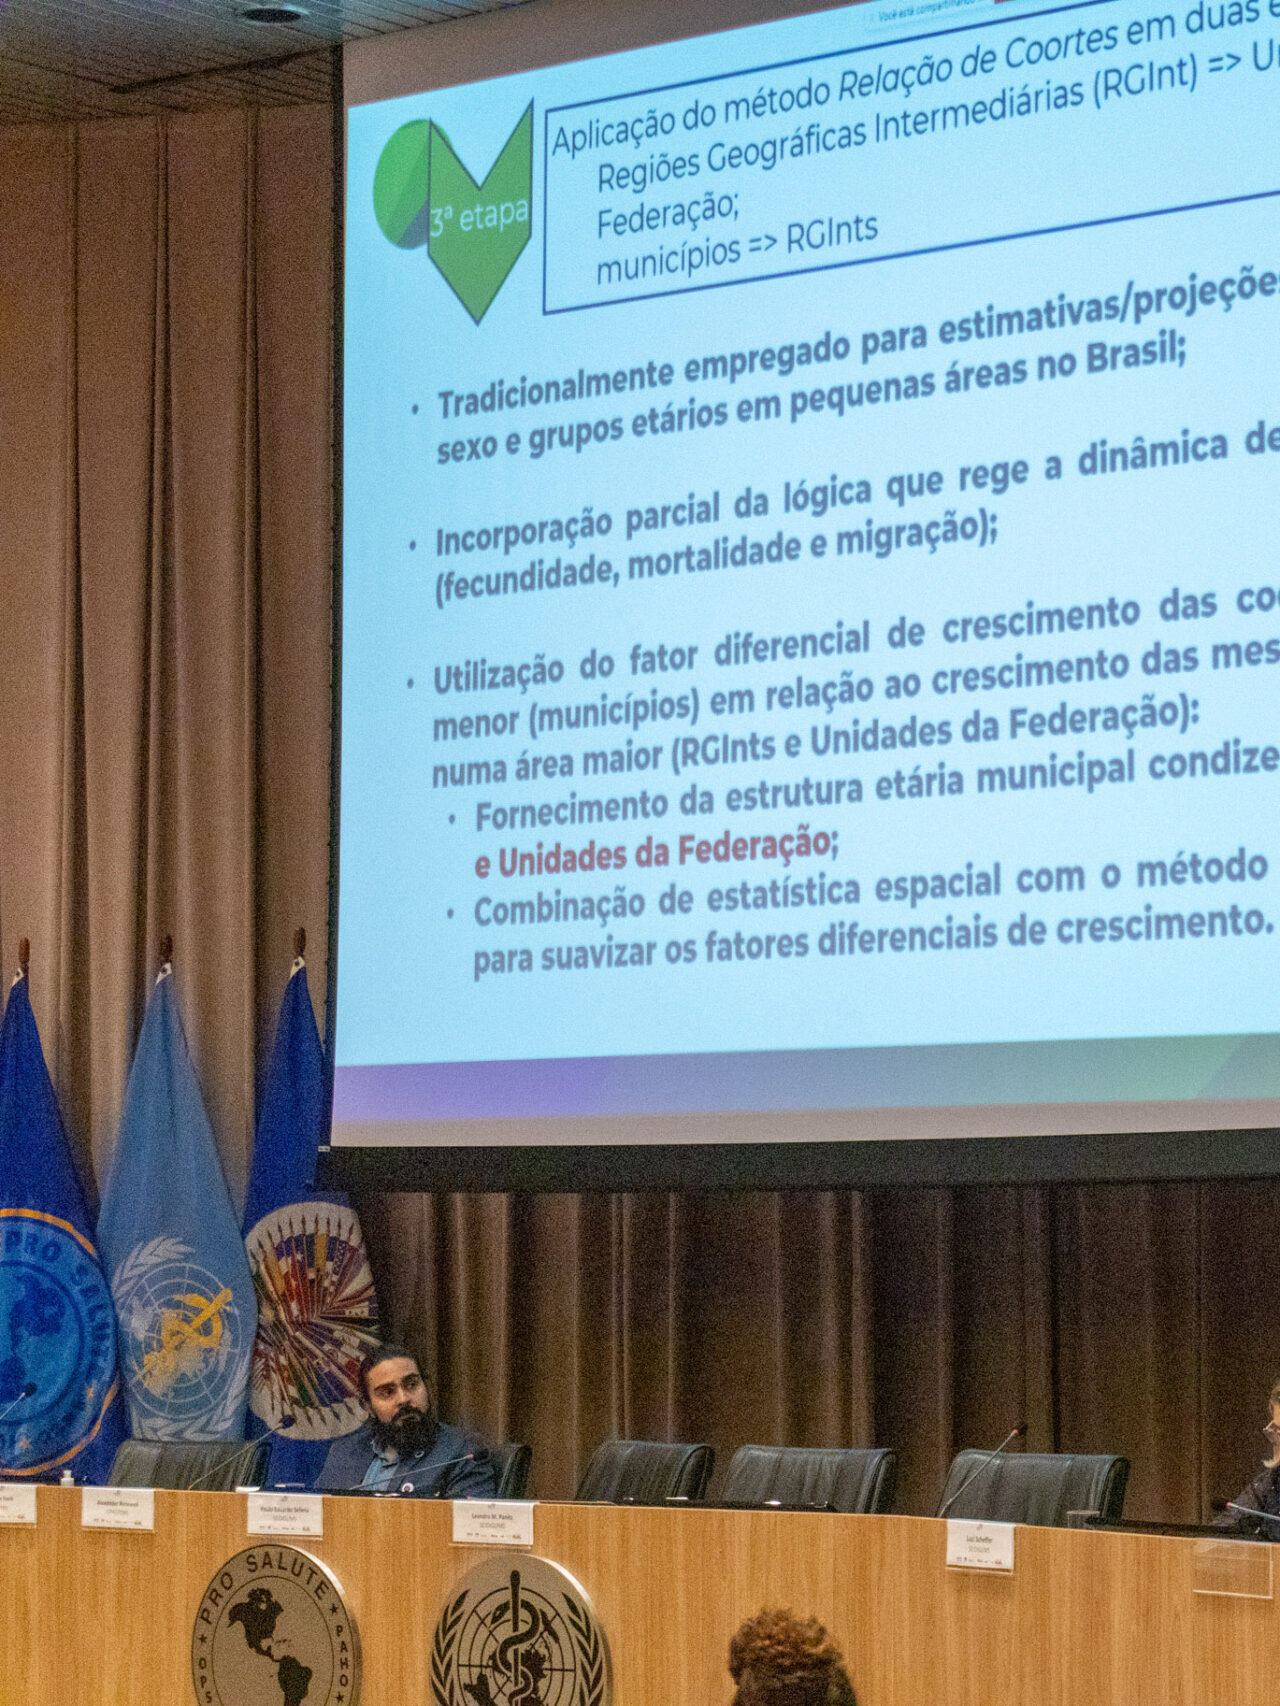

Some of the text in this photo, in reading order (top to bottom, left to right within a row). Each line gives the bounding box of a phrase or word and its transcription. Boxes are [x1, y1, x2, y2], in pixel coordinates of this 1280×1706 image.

[552, 109, 676, 160] Aplicação
[682, 99, 716, 131] do
[725, 77, 831, 123] método
[838, 55, 953, 101] Relação
[960, 44, 997, 78] de
[1005, 25, 1119, 69] Coortes
[1126, 14, 1176, 46] em
[1185, 0, 1260, 34] duas
[598, 153, 700, 194] Regiões
[707, 122, 867, 172] Geográficas
[876, 79, 1085, 143] Intermediárias
[1093, 52, 1198, 110] (RGInt)
[460, 199, 528, 232] etapa
[597, 237, 741, 285] municípios
[787, 215, 878, 254] RGInts
[598, 191, 739, 239] Federação;
[437, 328, 1186, 465] sexo e grupos etários em pequenas áreas no Brasil;
[438, 360, 675, 419] Tradicionalmente
[684, 330, 851, 384] empregado
[861, 324, 928, 365] para
[437, 506, 613, 556] Incorporação
[626, 490, 720, 541] parcial
[734, 486, 769, 519] da
[784, 473, 872, 518] lógica
[886, 470, 944, 508] que
[959, 459, 1030, 496] rege
[1044, 455, 1062, 481] a
[1078, 427, 1229, 476] dinâmica
[436, 507, 998, 609] (fecundidade, mortalidade e migração);
[434, 653, 564, 695] Utilização
[579, 648, 615, 680] do
[629, 643, 698, 675] fator
[714, 619, 870, 667] diferencial
[887, 615, 926, 649] de
[942, 596, 1141, 644] crescimento
[1159, 586, 1218, 622] das
[433, 711, 519, 741] menor
[529, 686, 700, 740] (municípios)
[710, 688, 755, 716] em
[766, 670, 874, 715] relação
[884, 672, 921, 700] ao
[931, 649, 1130, 695] crescimento
[1140, 640, 1200, 676] das
[433, 692, 1200, 788] numa área maior (RGInts e Unidades da Federação):
[476, 790, 669, 832] Fornecimento
[679, 783, 714, 816] da
[725, 776, 863, 812] estrutura
[875, 761, 964, 801] etária
[977, 747, 1135, 794] municipal
[474, 885, 645, 928] Combinação
[658, 882, 694, 915] de
[707, 871, 861, 912] estatística
[875, 861, 1001, 909] espacial
[1016, 865, 1085, 894] com
[1101, 863, 1122, 889] o
[1137, 846, 1269, 888] método
[475, 823, 839, 879] e Unidades da Federação;
[474, 903, 1274, 982] para suavizar os fatores diferenciais de crescimento.
[200, 1551, 330, 1625] PRO SALUTE
[198, 1657, 212, 1704] OPS
[336, 1625, 349, 1687] PAHO
